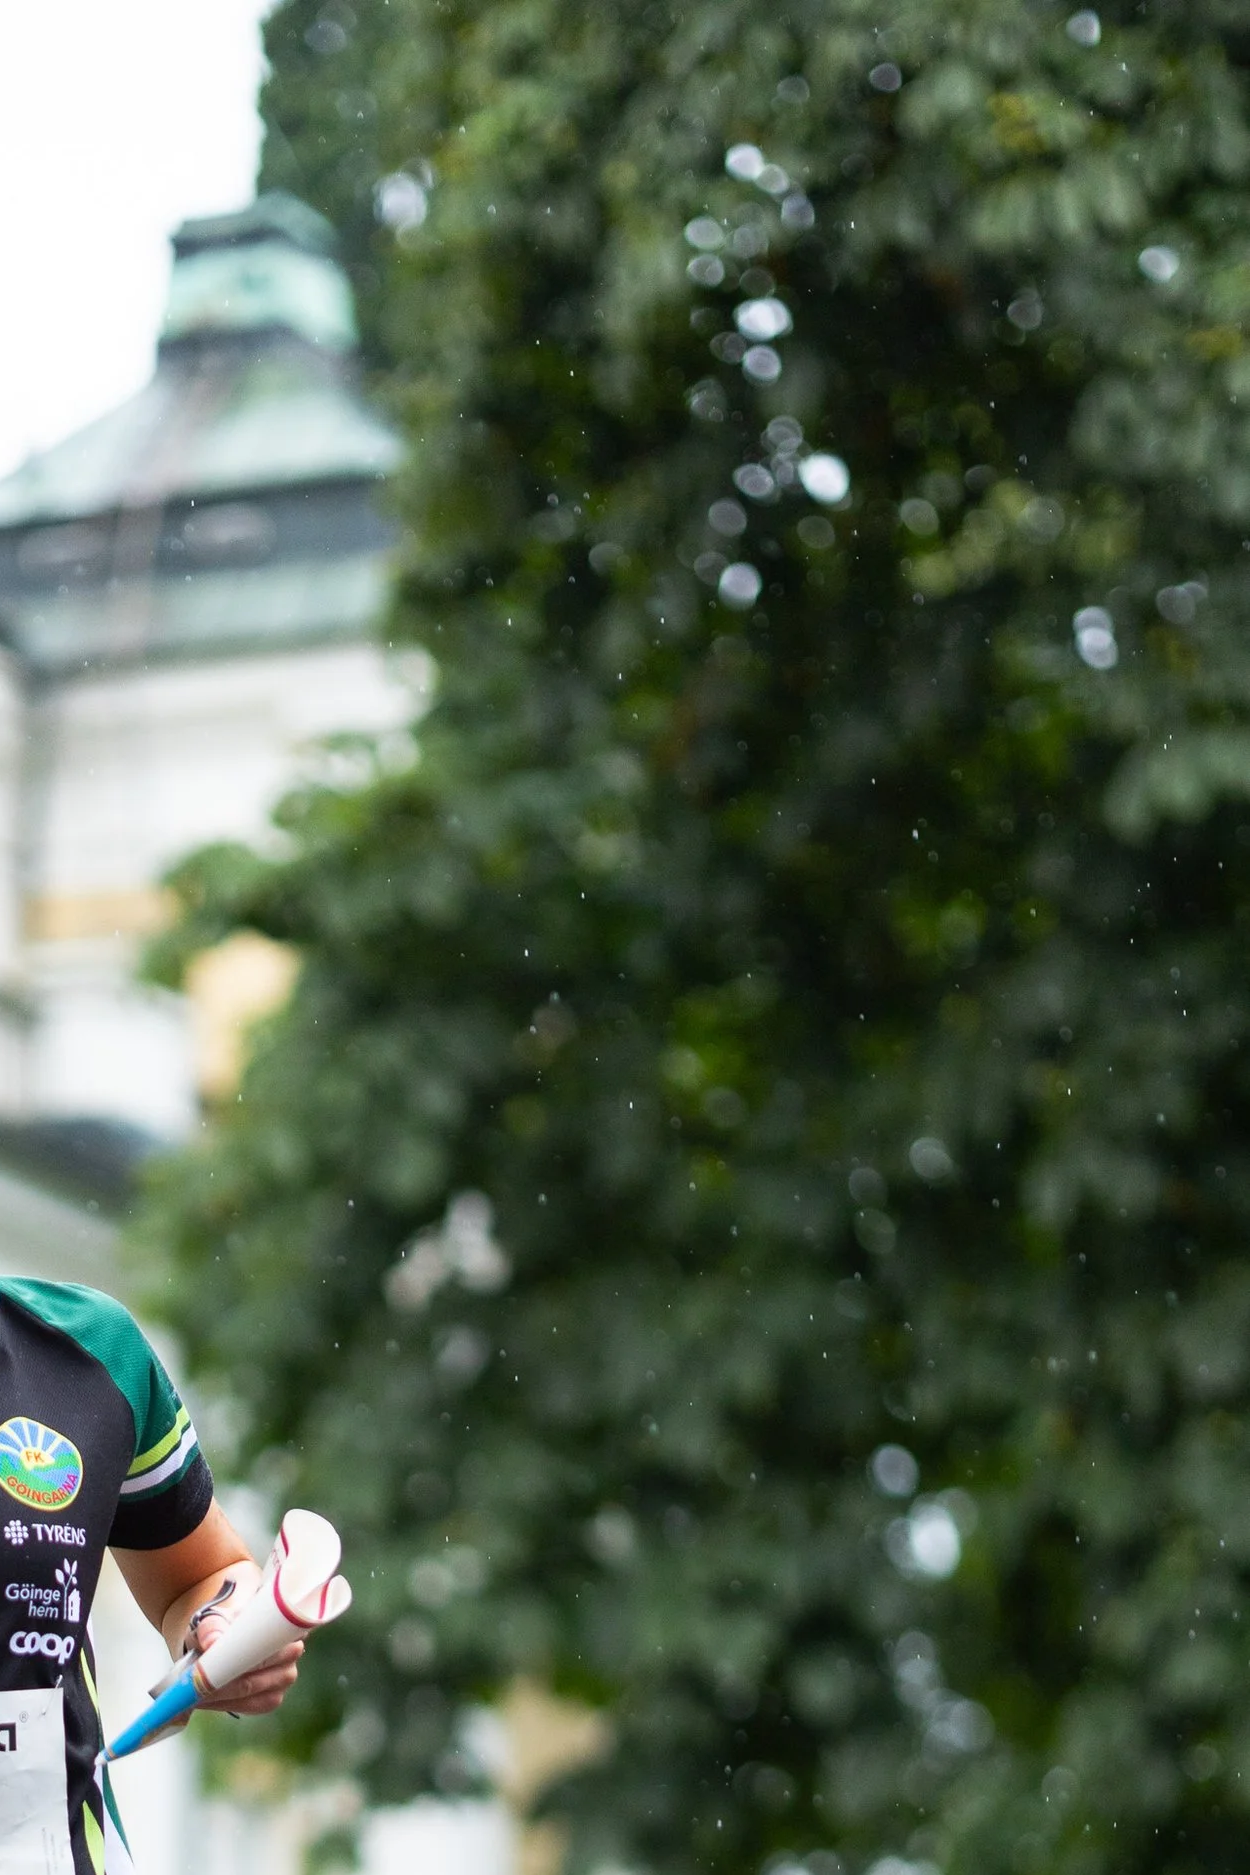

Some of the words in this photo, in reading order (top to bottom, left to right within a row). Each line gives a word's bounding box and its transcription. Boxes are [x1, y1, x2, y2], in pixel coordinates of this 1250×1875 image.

[25, 1451, 44, 1463] FK
[5, 1583, 61, 1604] Göinge
[28, 1600, 59, 1618] hem
[9, 1631, 75, 1664] coop
